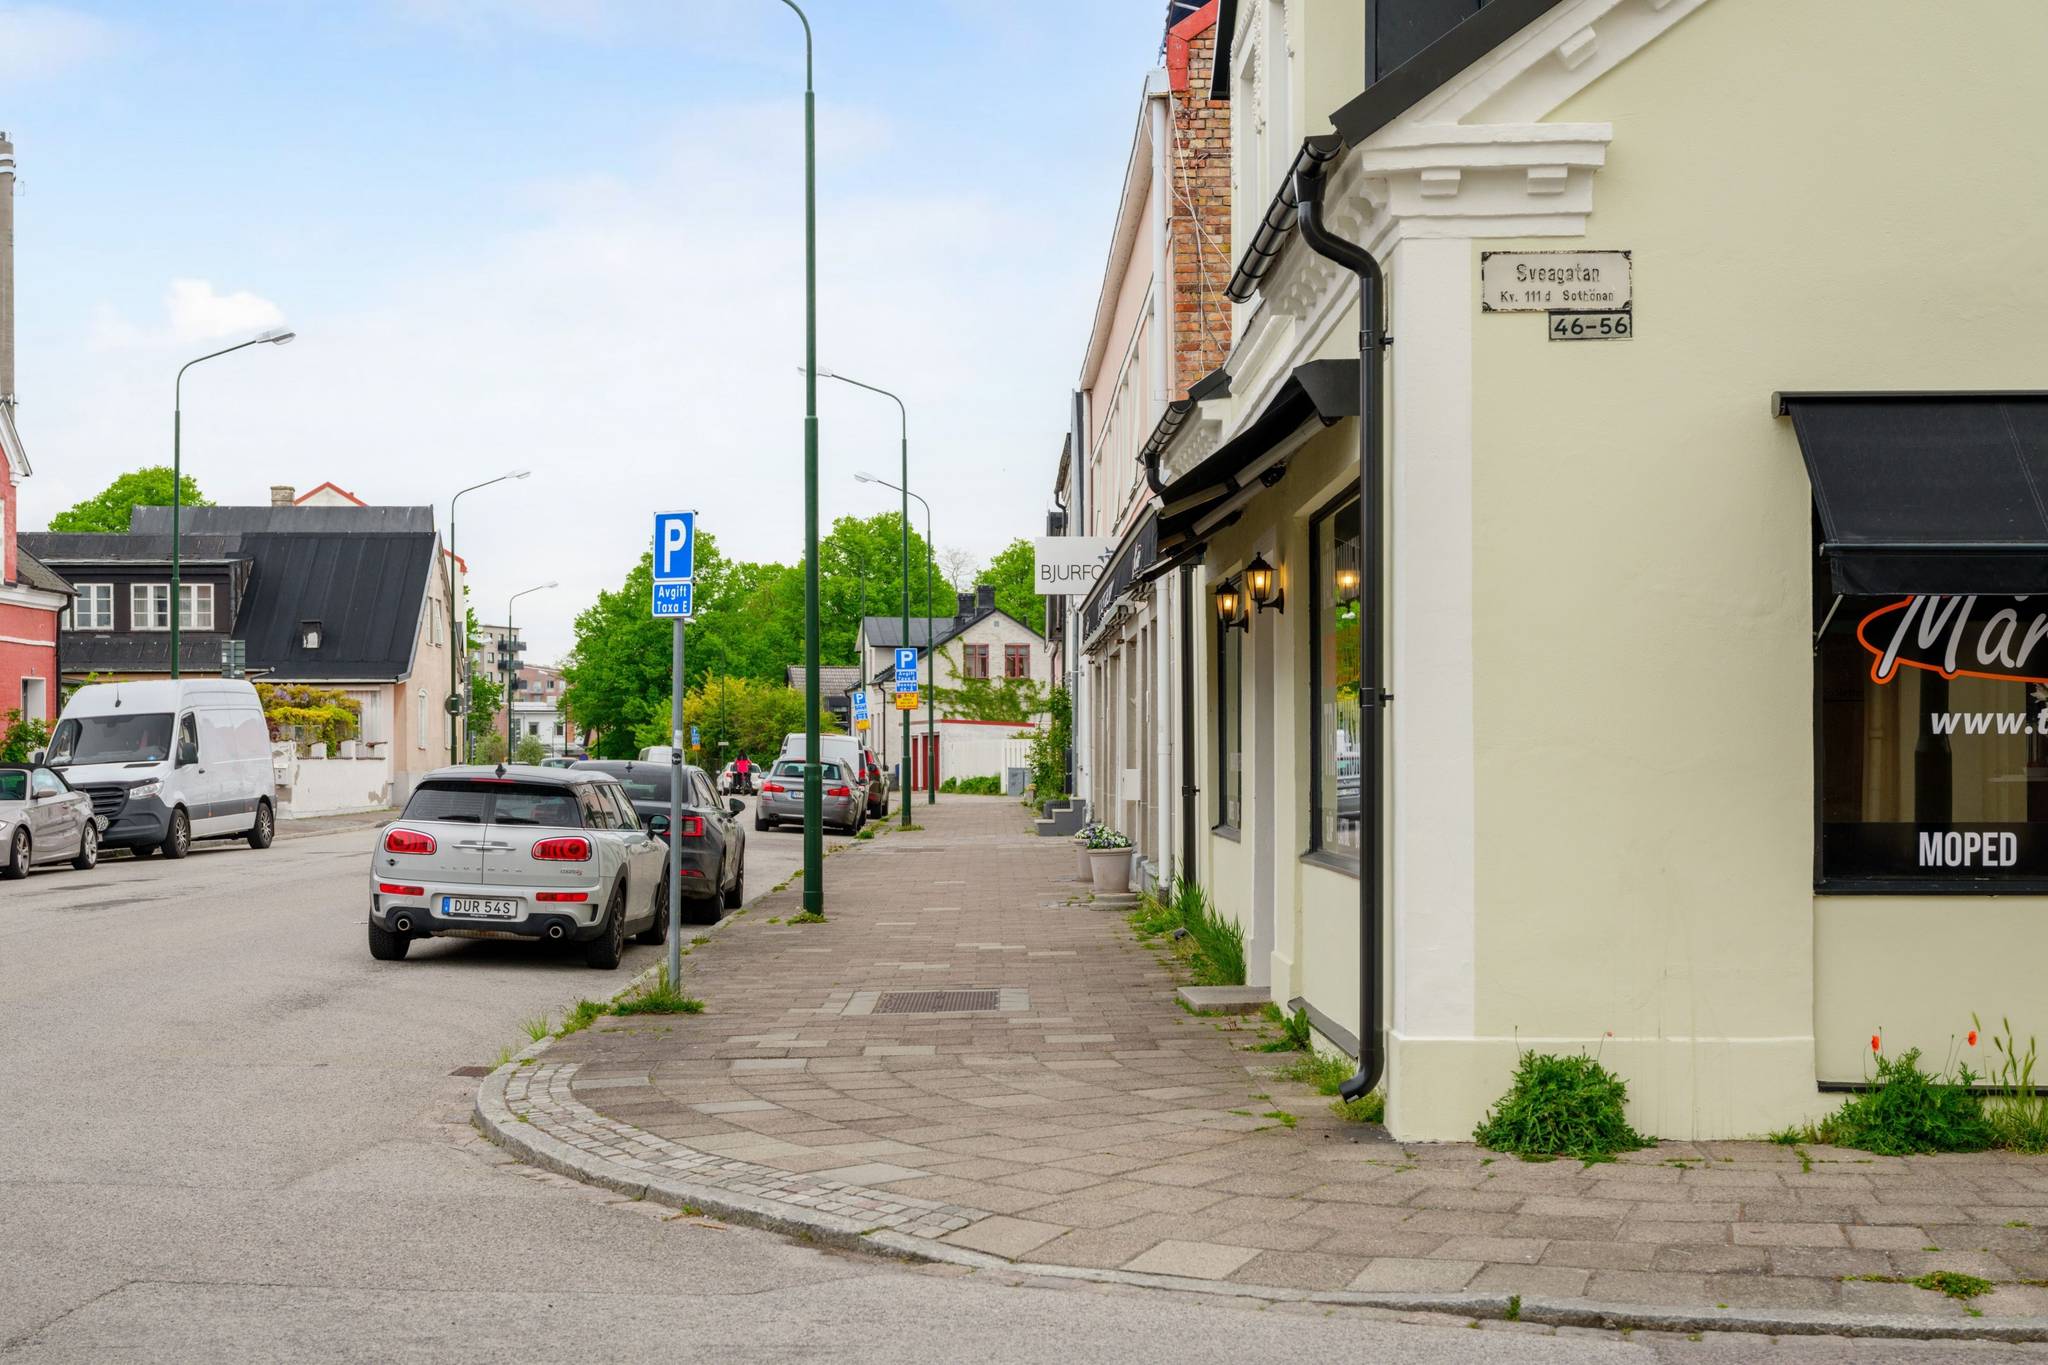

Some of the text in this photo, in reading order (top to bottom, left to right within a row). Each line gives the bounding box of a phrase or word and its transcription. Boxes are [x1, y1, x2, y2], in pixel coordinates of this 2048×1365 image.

[1516, 263, 1600, 284] Sveagatan
[1500, 290, 1518, 302] Kv.
[1553, 317, 1628, 335] 46-56
[664, 519, 687, 573] P
[1041, 564, 1105, 583] BJURFO
[658, 585, 687, 600] Avgift
[656, 600, 688, 613] Taxa E
[900, 650, 914, 669] P
[1918, 831, 2018, 868] MOPED
[454, 899, 510, 914] DUR 54S
